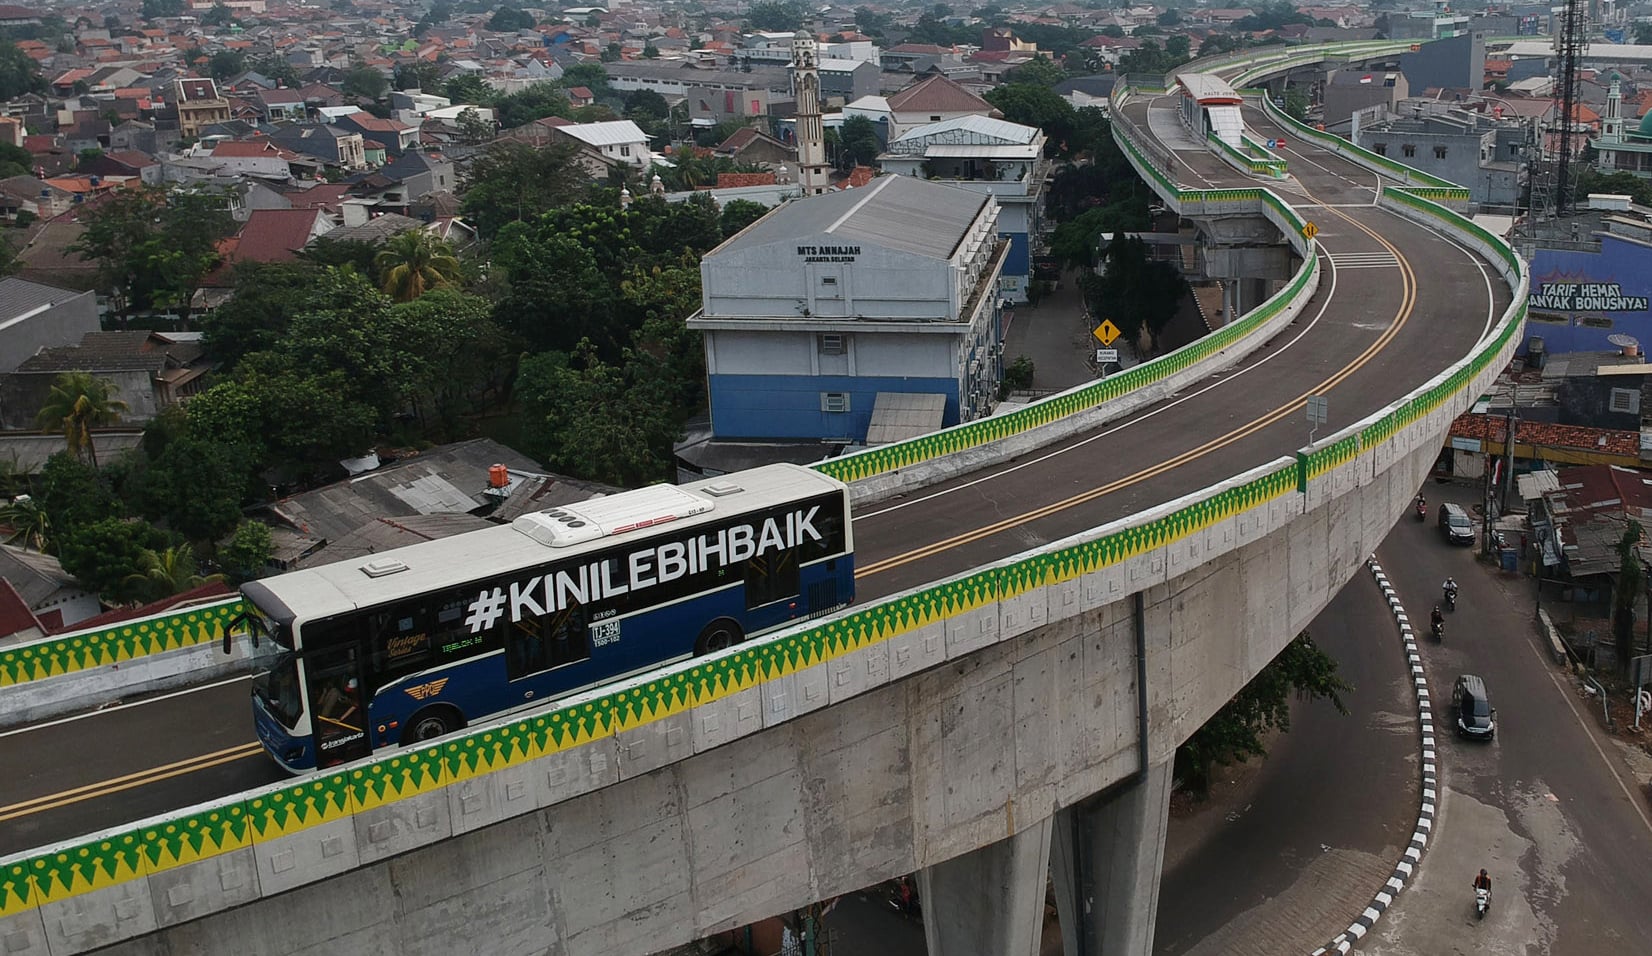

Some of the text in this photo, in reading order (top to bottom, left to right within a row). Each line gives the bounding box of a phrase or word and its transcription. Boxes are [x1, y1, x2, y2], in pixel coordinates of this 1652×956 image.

[797, 246, 861, 255] MTS ANNAJAH
[1542, 284, 1621, 297] TARIF HEMAT
[1528, 295, 1647, 310] ANYAK BONUSNYA!
[464, 505, 823, 633] #KINILEBIHBAIK
[594, 621, 619, 639] TJ-394
